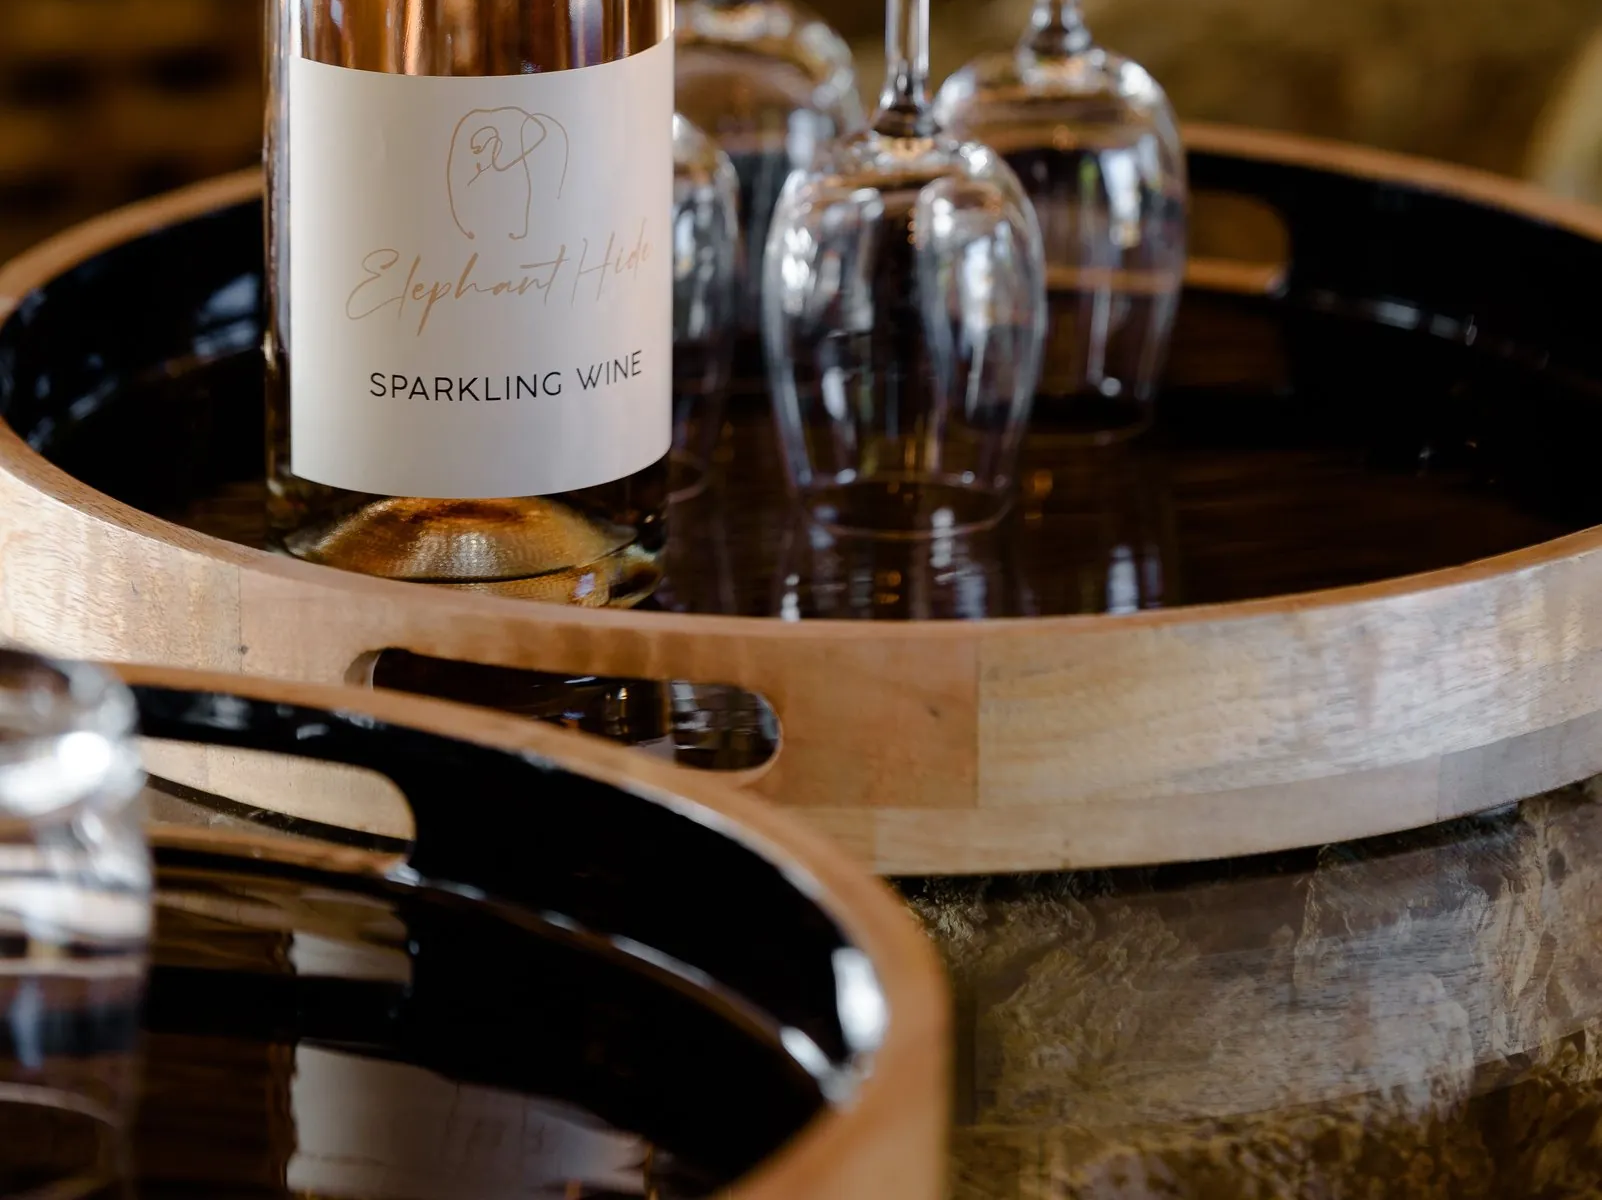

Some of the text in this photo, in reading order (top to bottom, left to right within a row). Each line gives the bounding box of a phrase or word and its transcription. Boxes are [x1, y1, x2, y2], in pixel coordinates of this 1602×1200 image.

[345, 217, 652, 337] Elephant Hide
[369, 349, 642, 402] SPARKLING WINE
